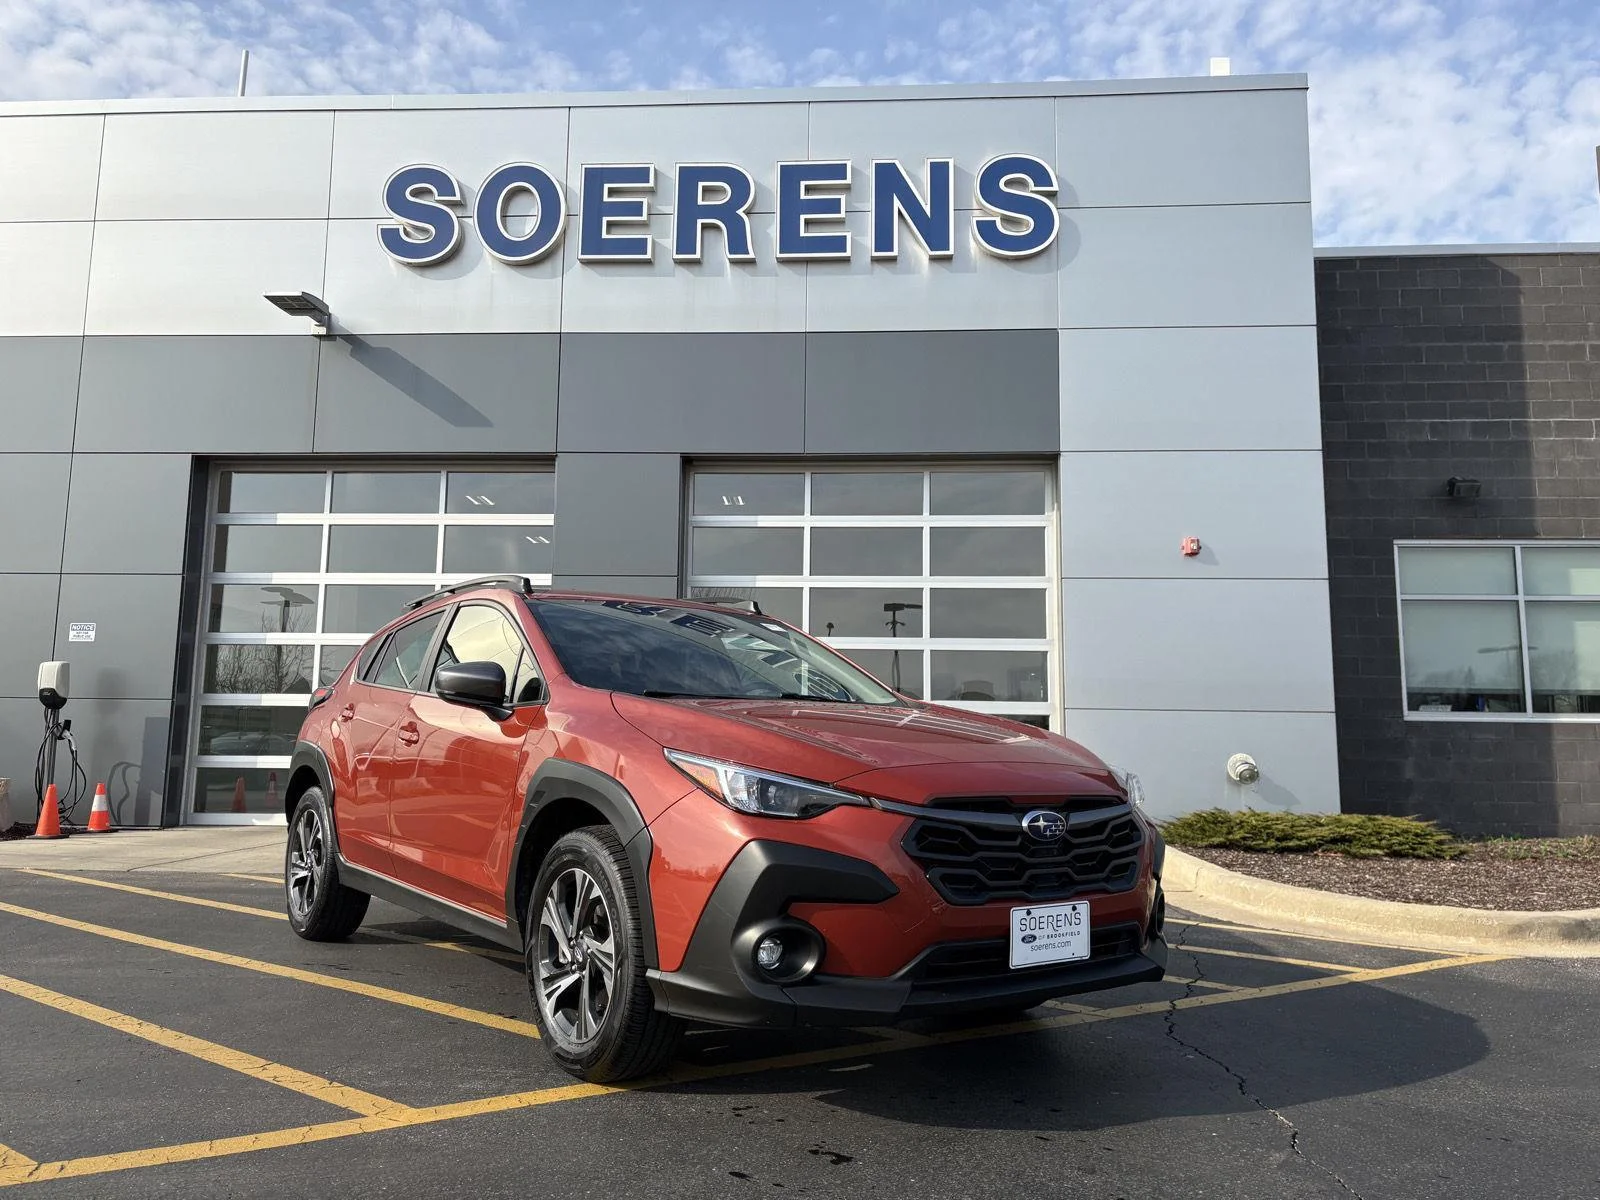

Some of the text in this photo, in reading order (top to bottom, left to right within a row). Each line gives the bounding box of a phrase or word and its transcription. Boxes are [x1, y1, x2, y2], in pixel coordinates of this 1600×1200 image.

[377, 154, 1059, 265] SOERENS
[1020, 912, 1081, 932] SOERENS
[1047, 931, 1080, 939] BROOKFIELD
[1030, 940, 1071, 951] soerens.com
